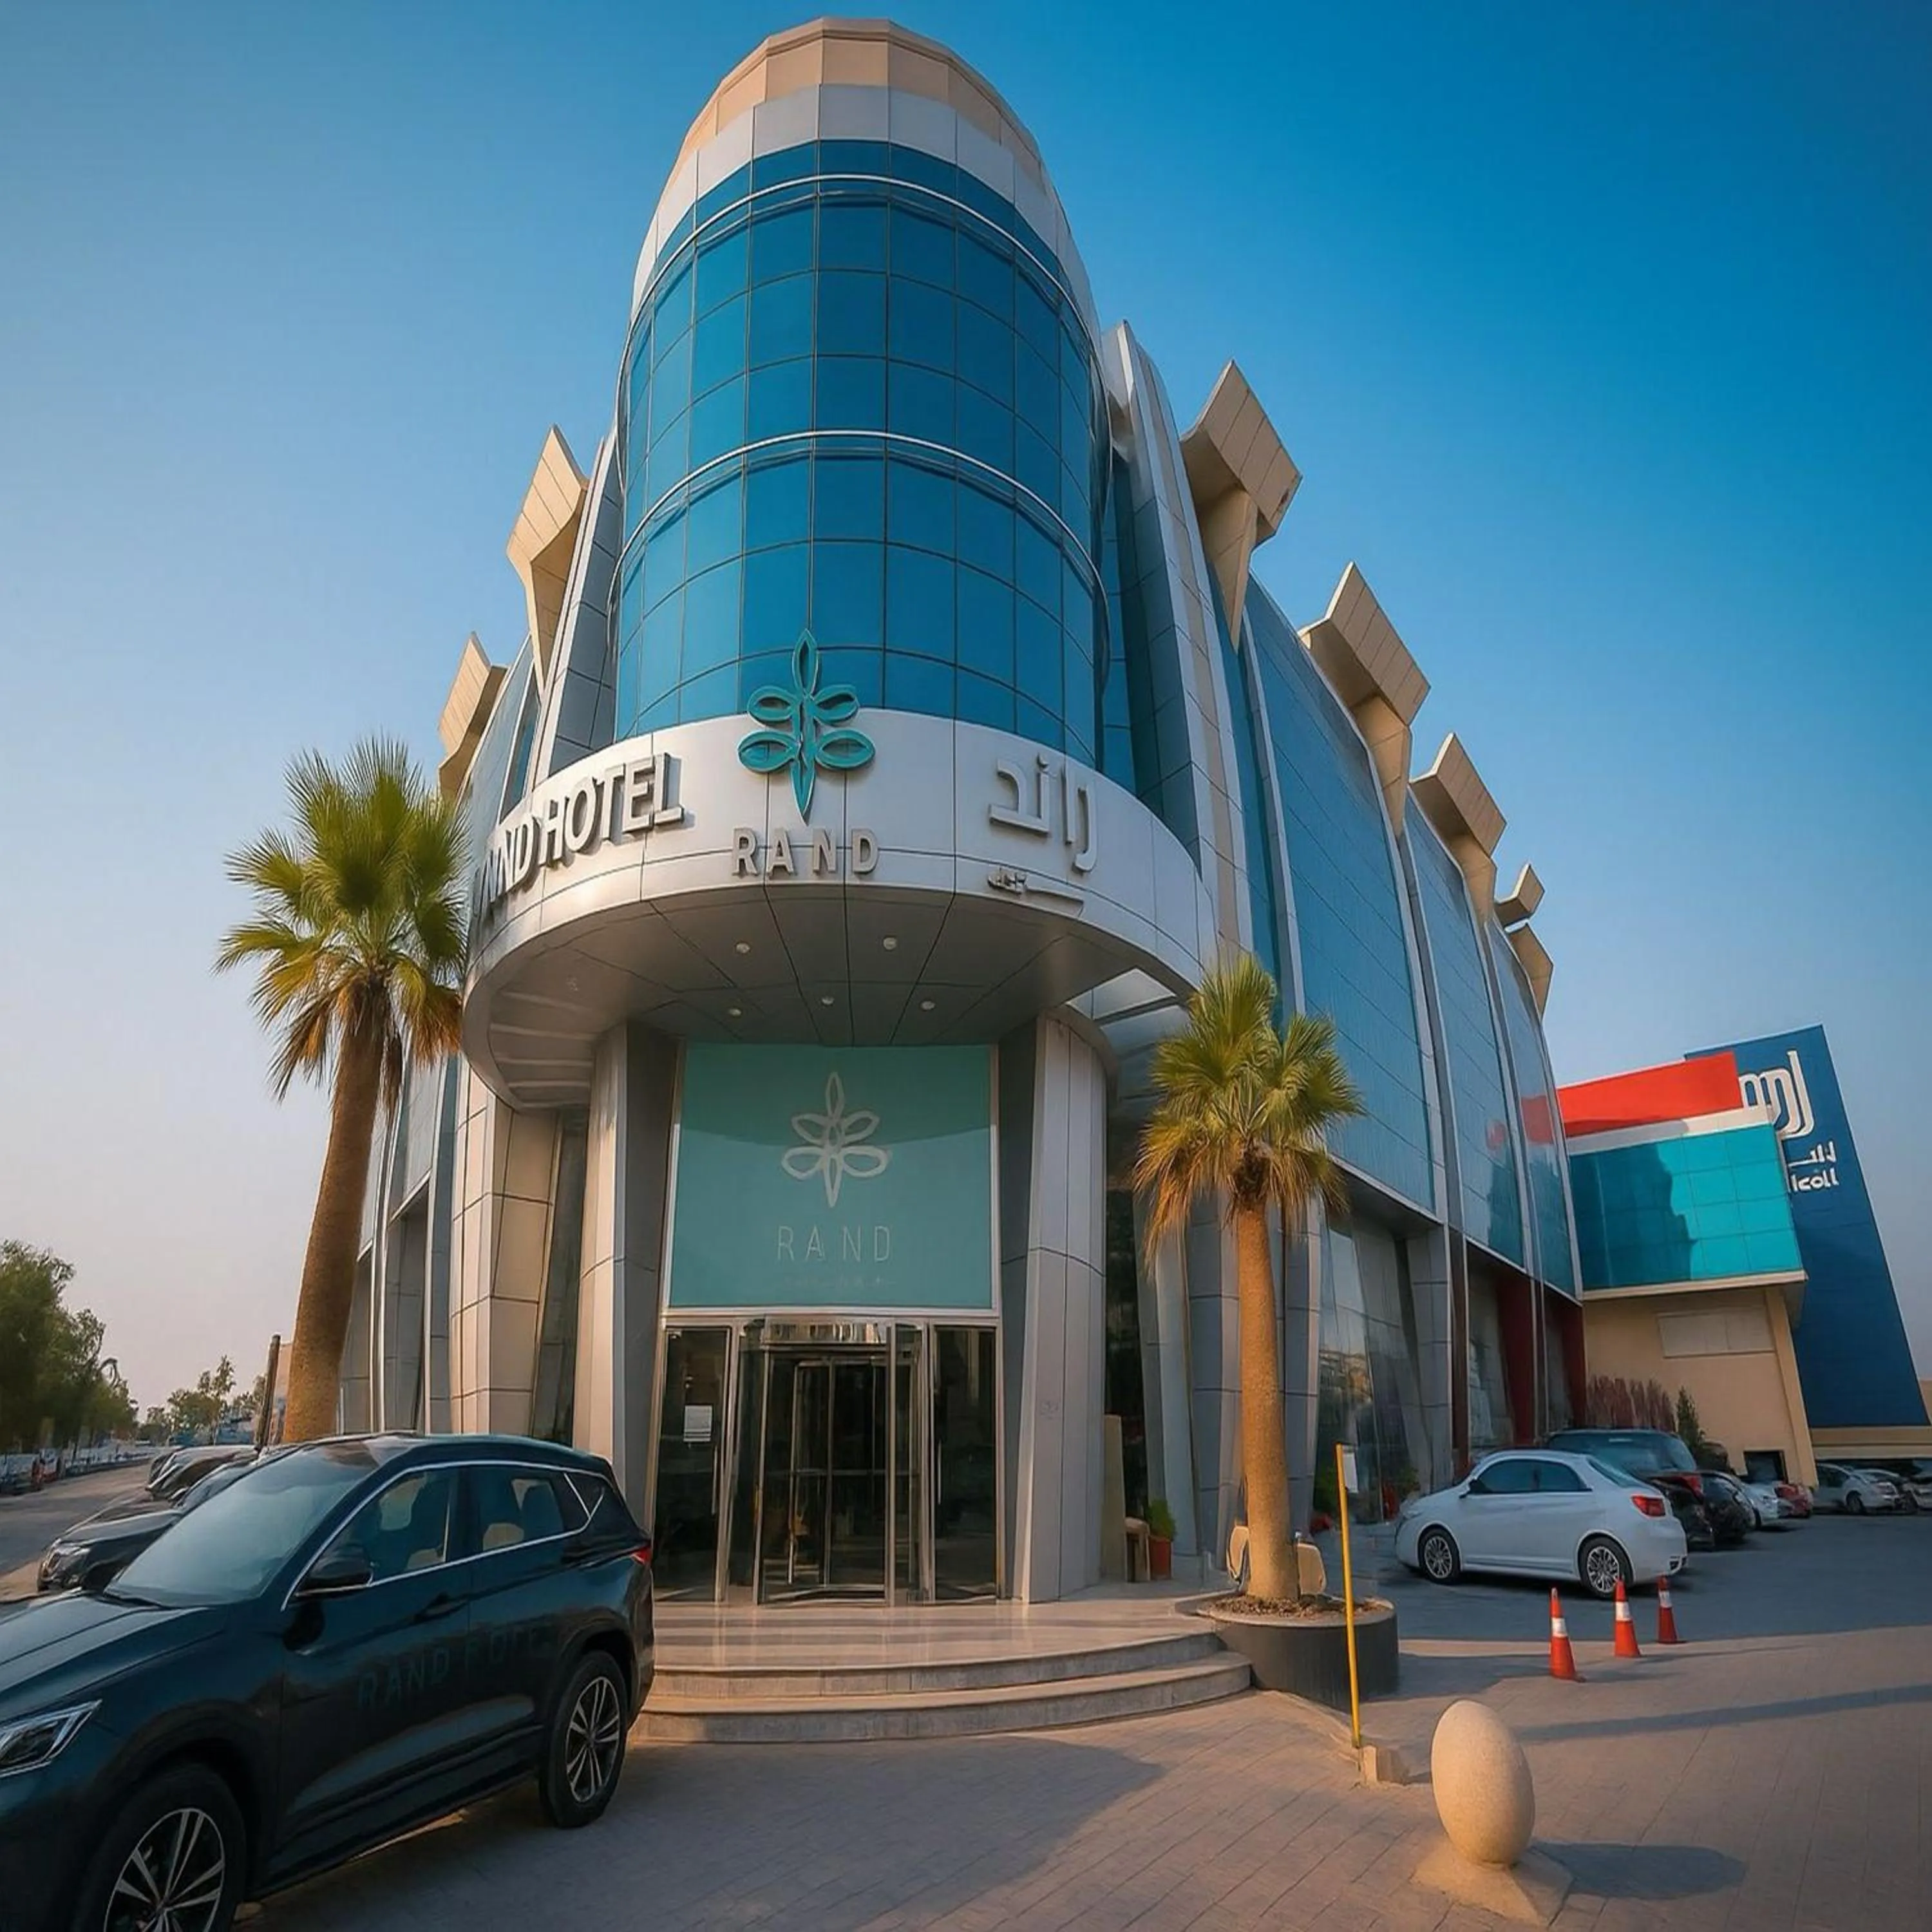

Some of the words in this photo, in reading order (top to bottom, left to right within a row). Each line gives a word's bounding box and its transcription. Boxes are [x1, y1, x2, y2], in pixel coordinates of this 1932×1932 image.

[538, 752, 684, 866] HOTEL
[732, 827, 879, 876] RAND
[777, 1225, 891, 1262] RAND
